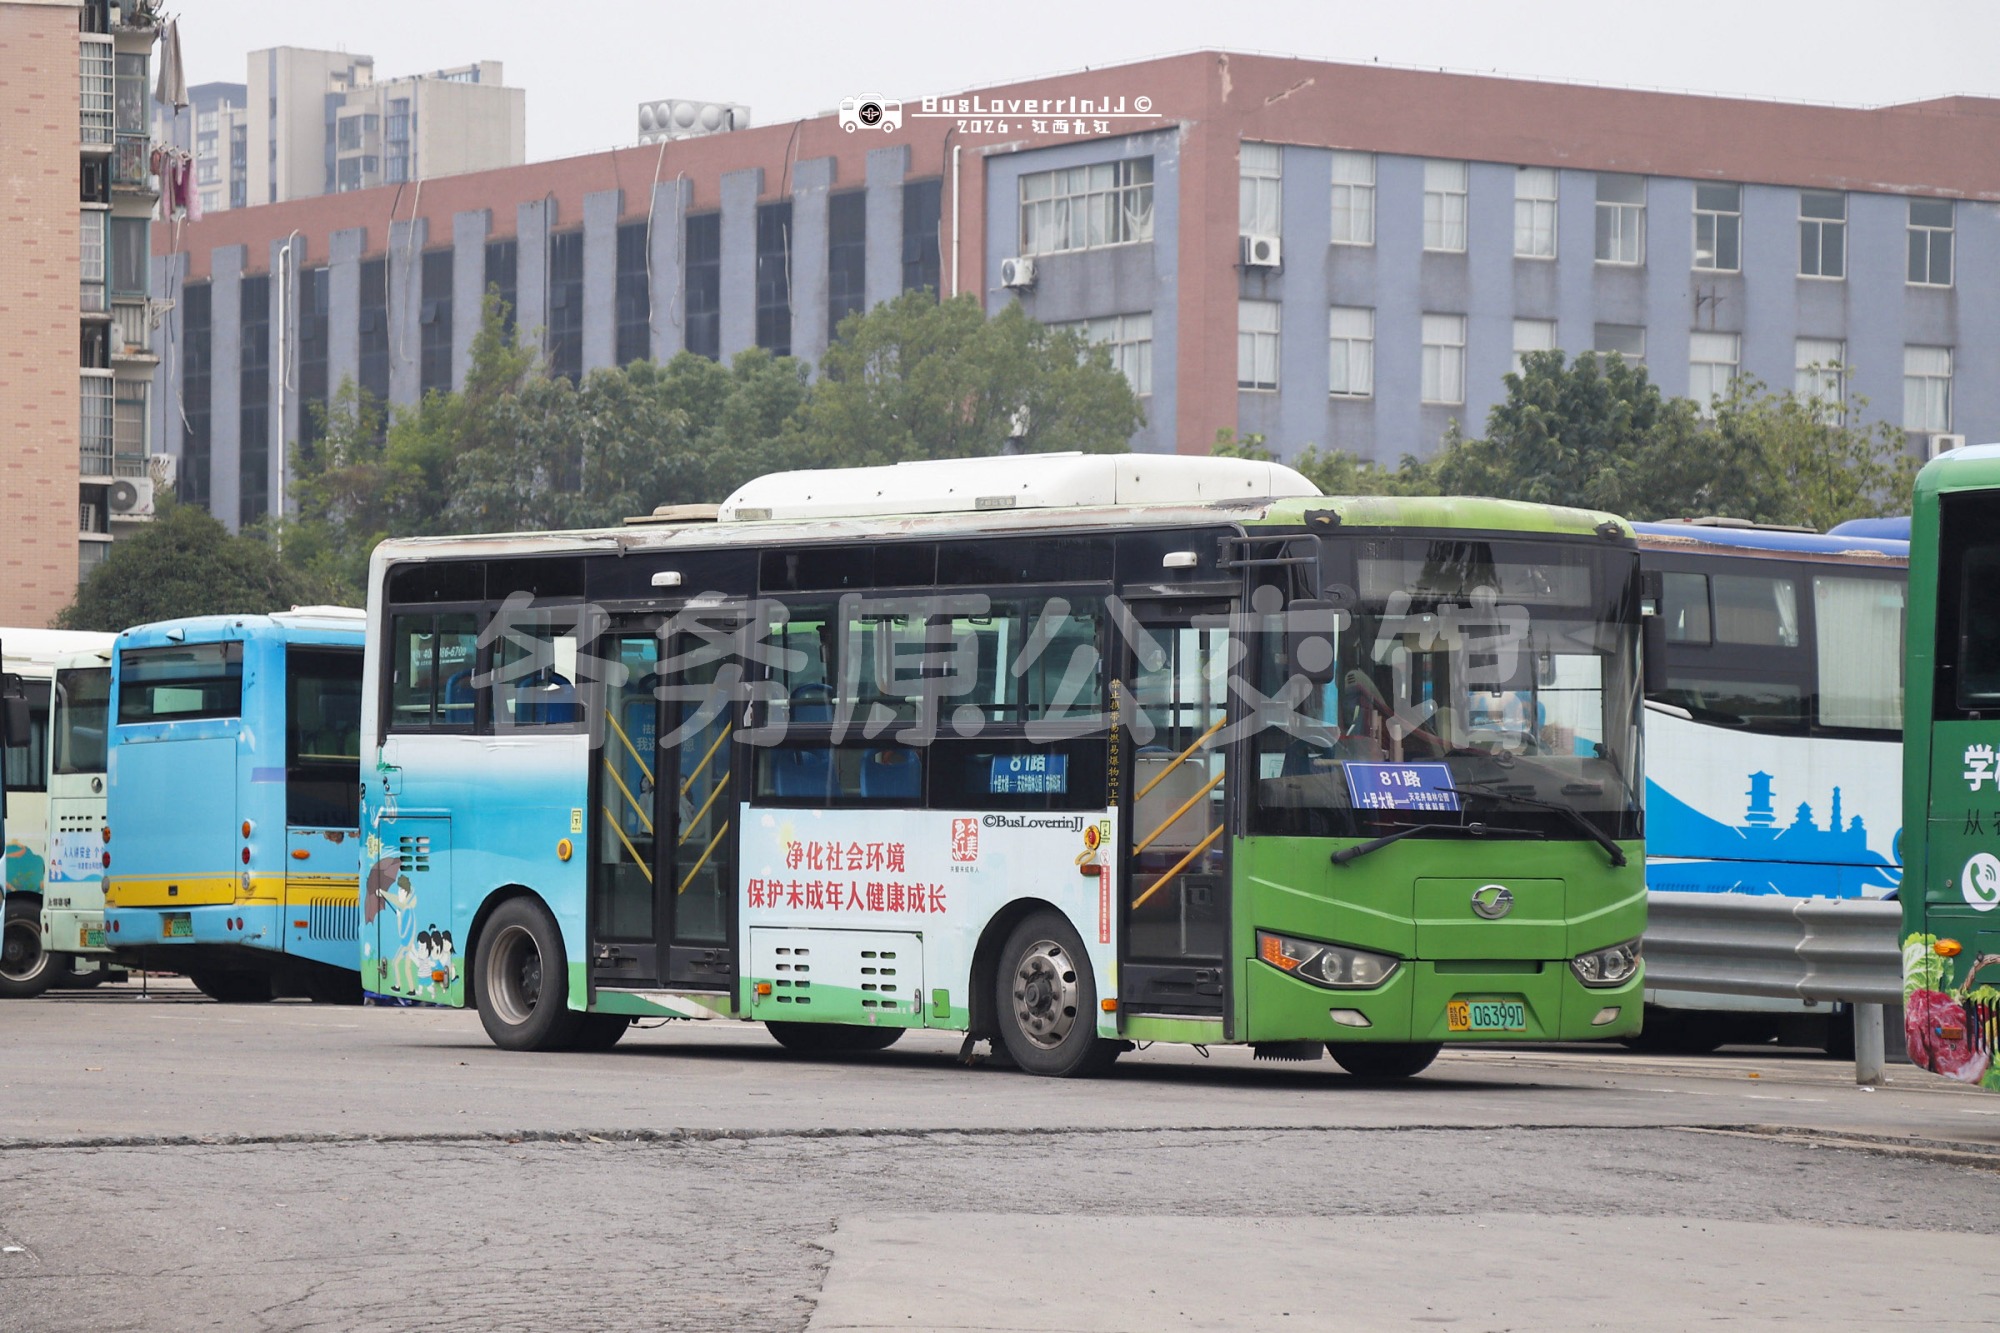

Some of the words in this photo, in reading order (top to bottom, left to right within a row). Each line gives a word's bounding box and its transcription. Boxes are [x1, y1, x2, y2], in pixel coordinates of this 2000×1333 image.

[1379, 770, 1421, 788] 81路
[785, 840, 906, 873] 净化社会环境
[747, 878, 947, 914] 保护未成年人健康成长
